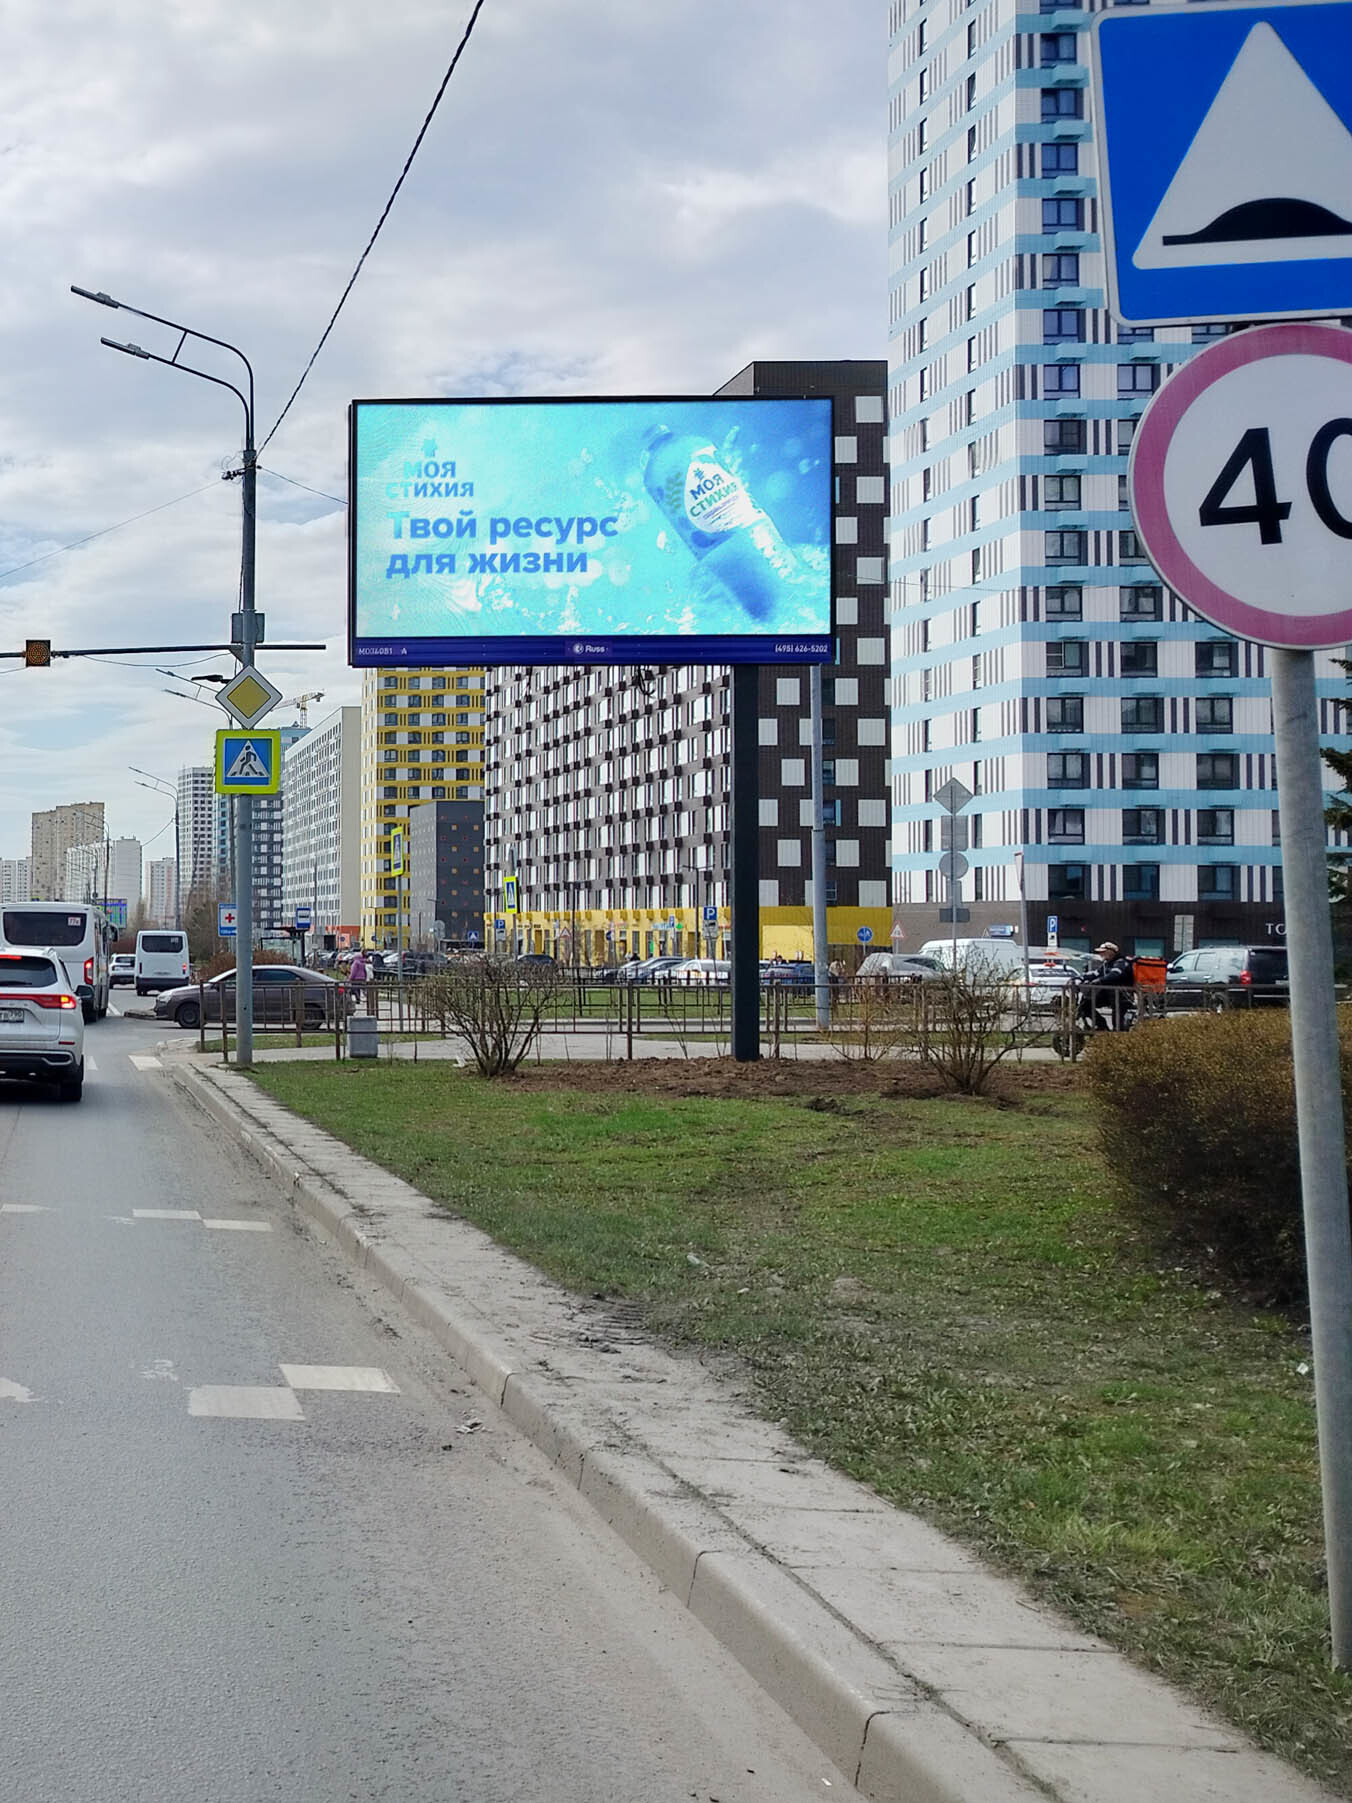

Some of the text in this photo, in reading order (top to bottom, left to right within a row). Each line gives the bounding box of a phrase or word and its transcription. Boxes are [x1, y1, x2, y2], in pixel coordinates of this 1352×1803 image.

[403, 461, 456, 479] МОЯ
[385, 481, 474, 499] СТИХИЯ
[690, 473, 724, 500] МОЯ
[386, 509, 619, 545] Твой ресурс
[386, 552, 588, 579] для жизни
[585, 644, 605, 653] Russ
[775, 643, 828, 653] (495) 626-5202
